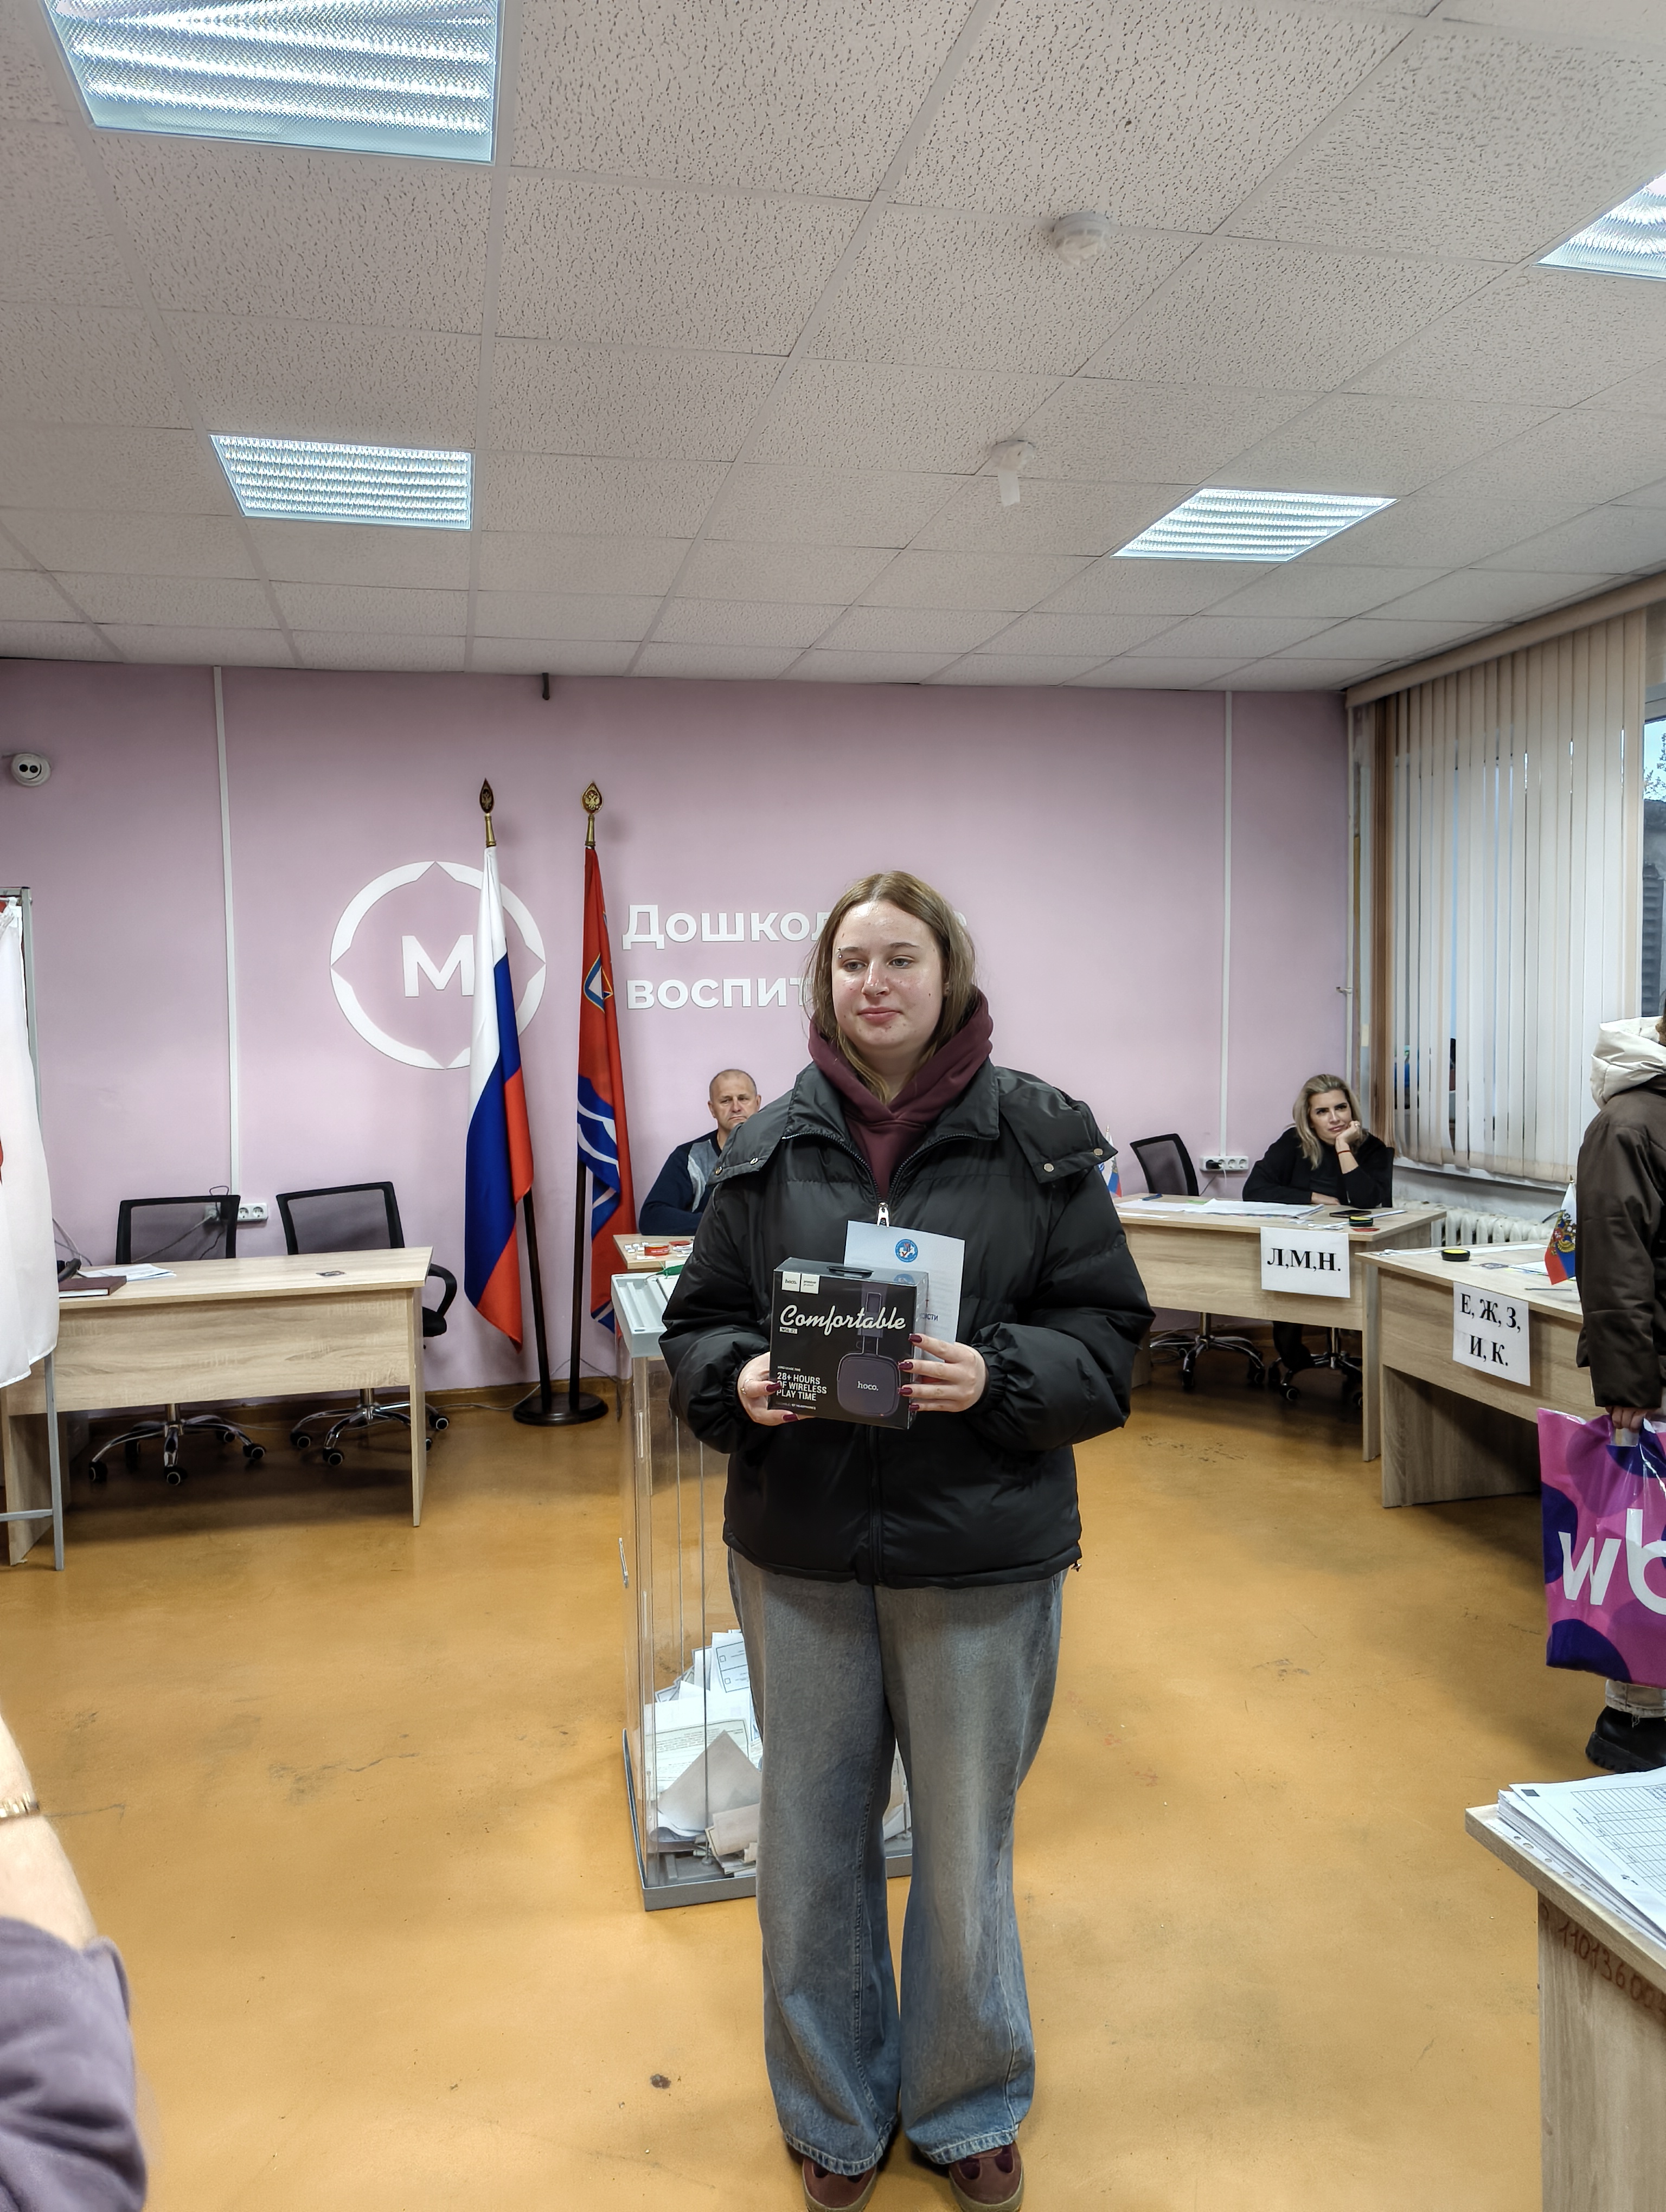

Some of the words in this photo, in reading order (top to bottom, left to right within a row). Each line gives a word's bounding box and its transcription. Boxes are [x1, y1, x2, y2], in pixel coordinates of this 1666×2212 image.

[622, 904, 967, 950] Дошкол
[627, 976, 813, 1009] воспит
[780, 1304, 906, 1336] Comfortable
[777, 1372, 792, 1380] 28+
[793, 1374, 821, 1385] HOURS
[789, 1381, 827, 1394] WIRELESS
[857, 1380, 879, 1391] hoco.
[776, 1389, 796, 1398] PLAY
[798, 1391, 817, 1401] TIME
